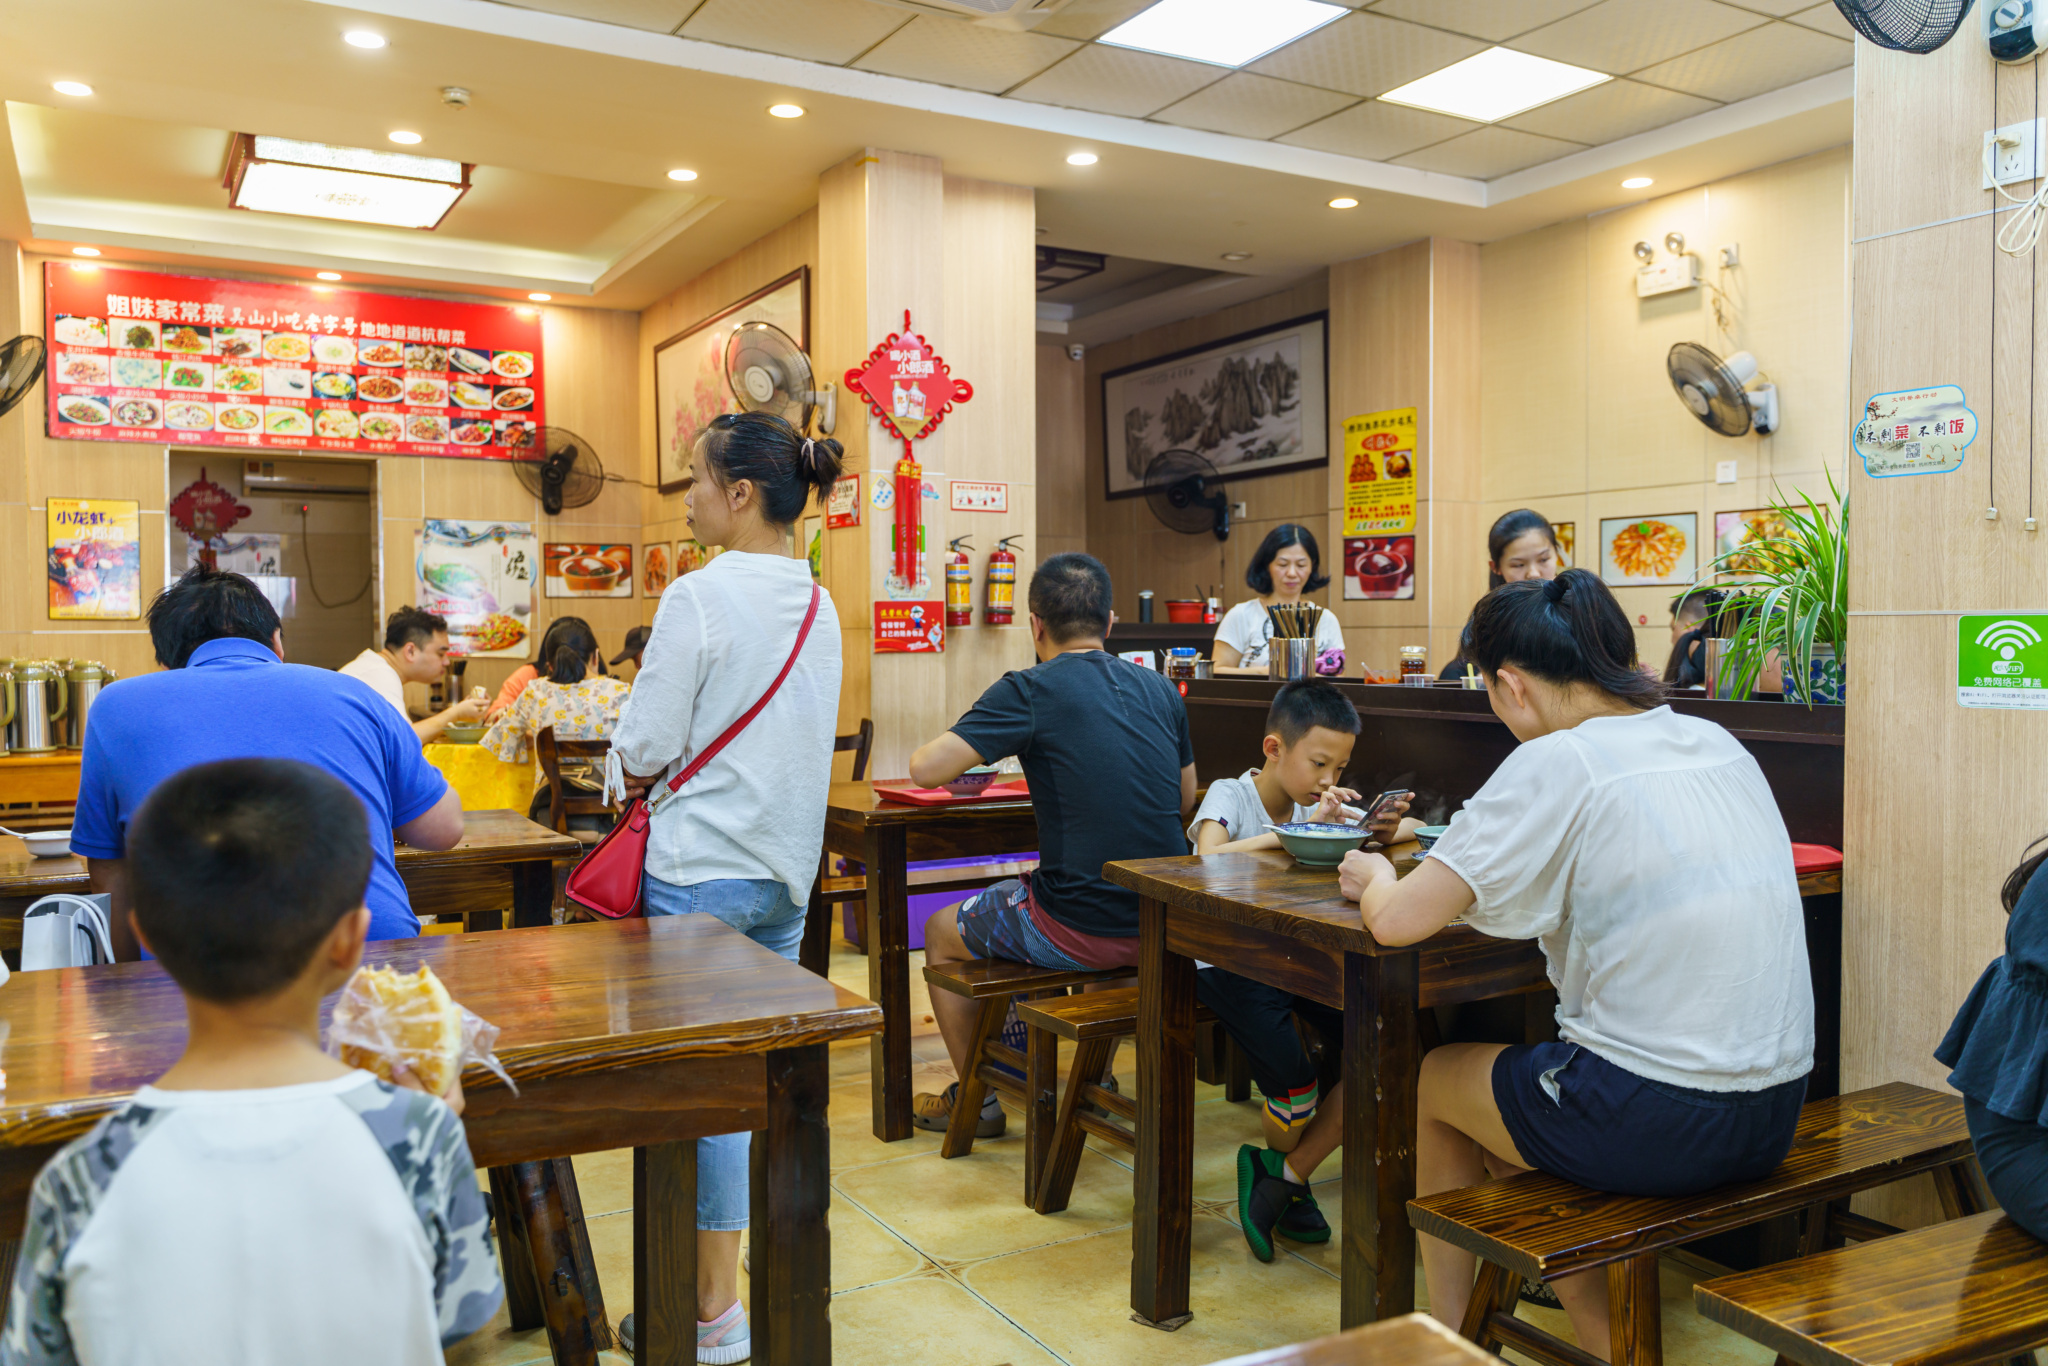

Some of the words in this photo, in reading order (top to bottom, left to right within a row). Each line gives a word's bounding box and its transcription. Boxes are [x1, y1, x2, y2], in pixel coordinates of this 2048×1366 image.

[106, 294, 225, 325] 姐妹家常菜
[360, 321, 466, 345] 地地道道杭帮菜
[889, 349, 921, 361] 喝小酒
[897, 360, 935, 375] 小郎酒
[1891, 392, 1938, 403] 文明餐桌行动
[1865, 424, 1909, 443] 不剩菜
[1917, 418, 1965, 438] 不剩饭
[1974, 676, 2042, 688] 免费网络已覆盖
[1180, 684, 1186, 694] 9
